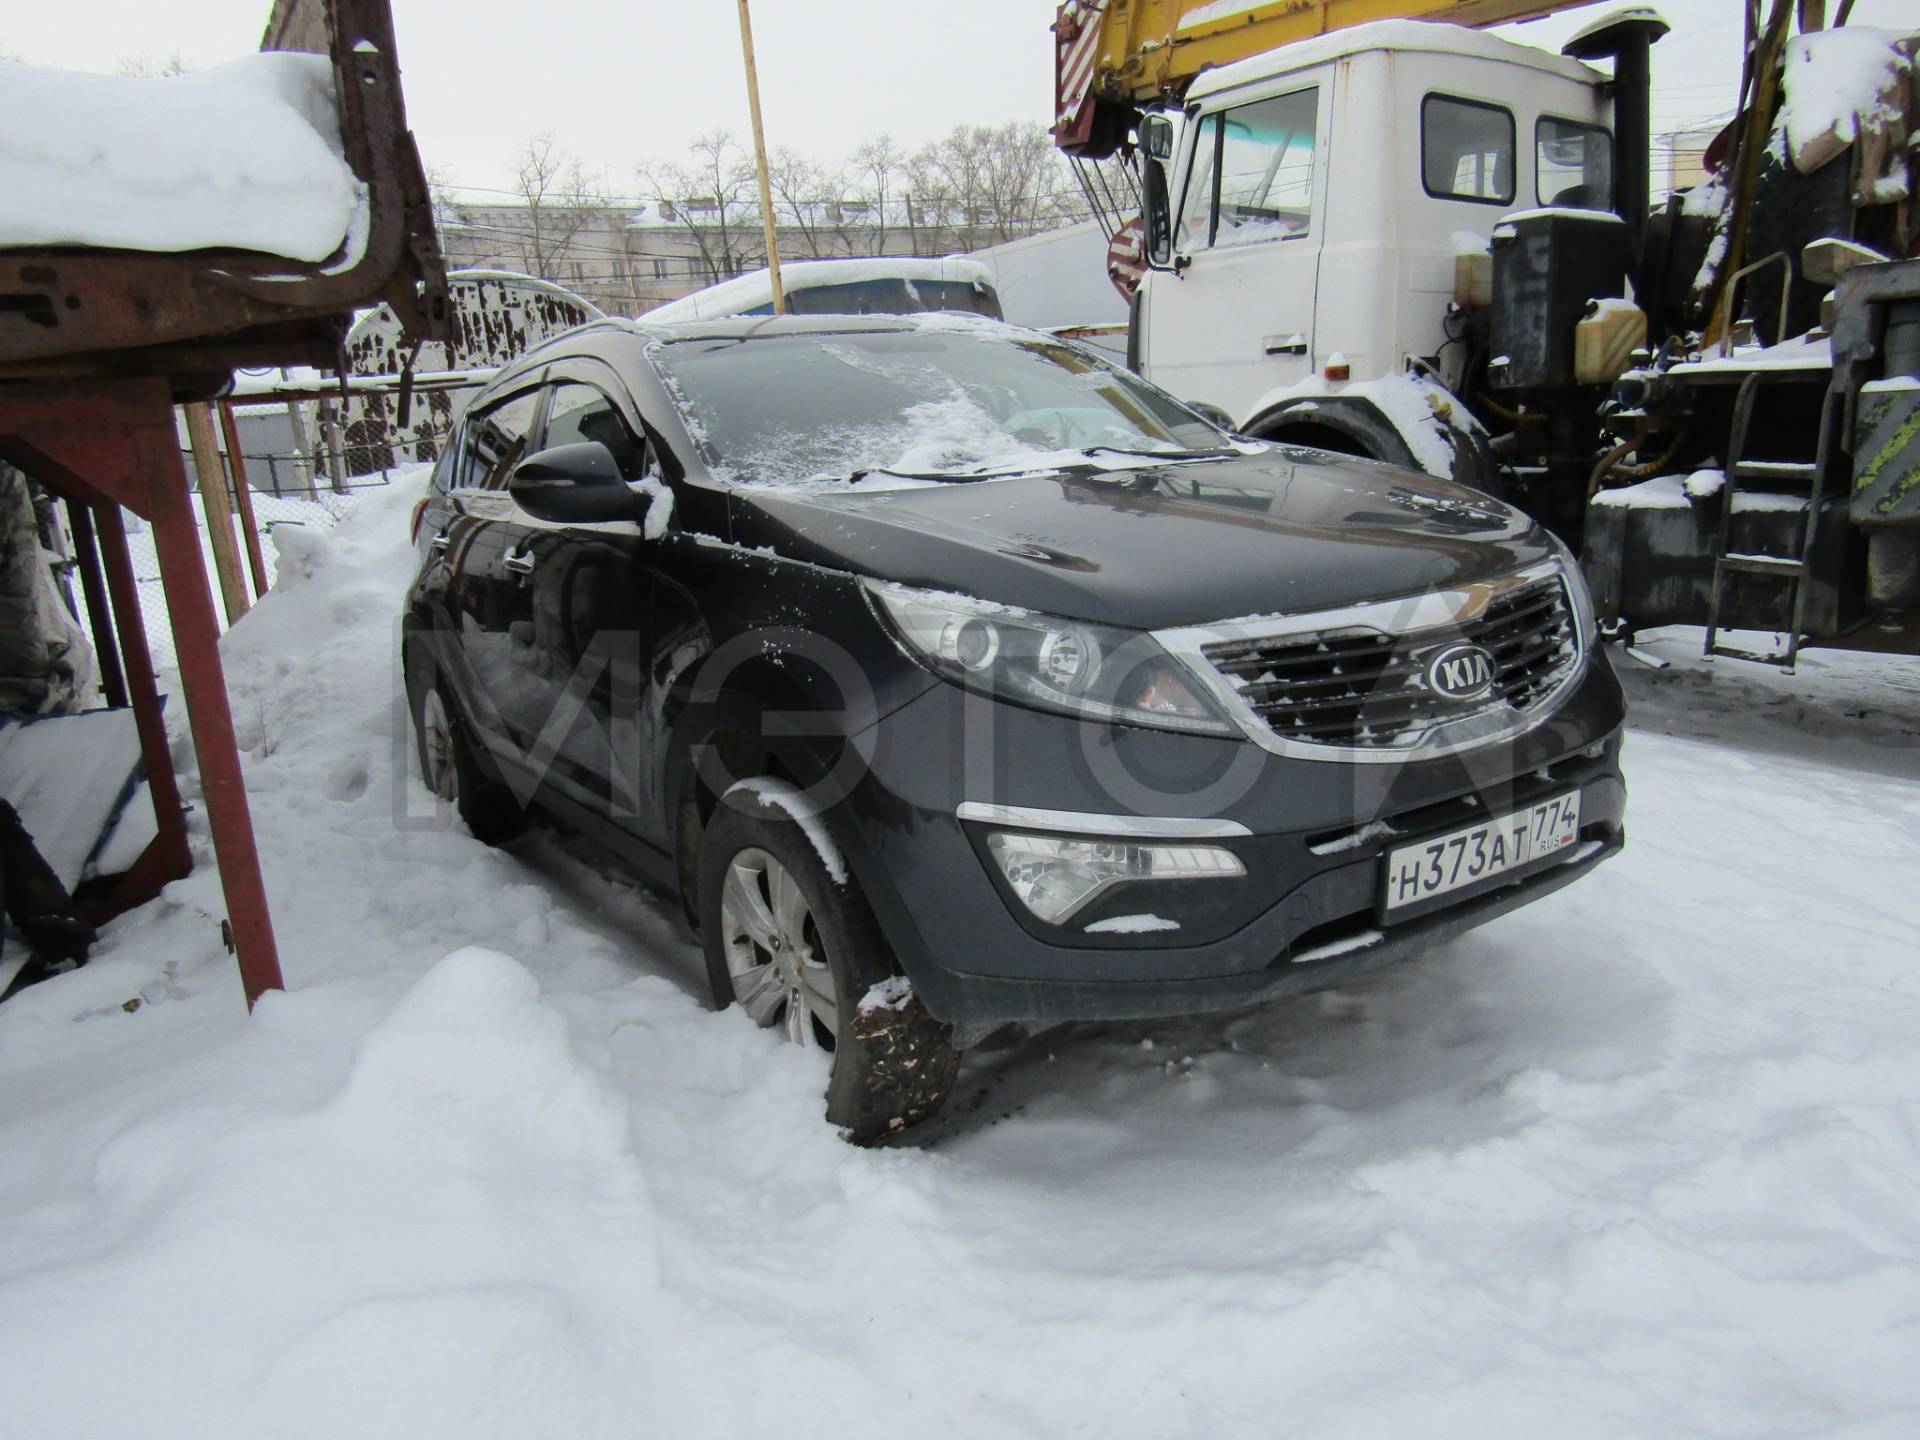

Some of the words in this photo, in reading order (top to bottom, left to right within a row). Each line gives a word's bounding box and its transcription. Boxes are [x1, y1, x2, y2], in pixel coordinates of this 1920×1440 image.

[1441, 654, 1491, 690] KIA
[1535, 796, 1573, 842] 774
[1539, 837, 1560, 852] RUS
